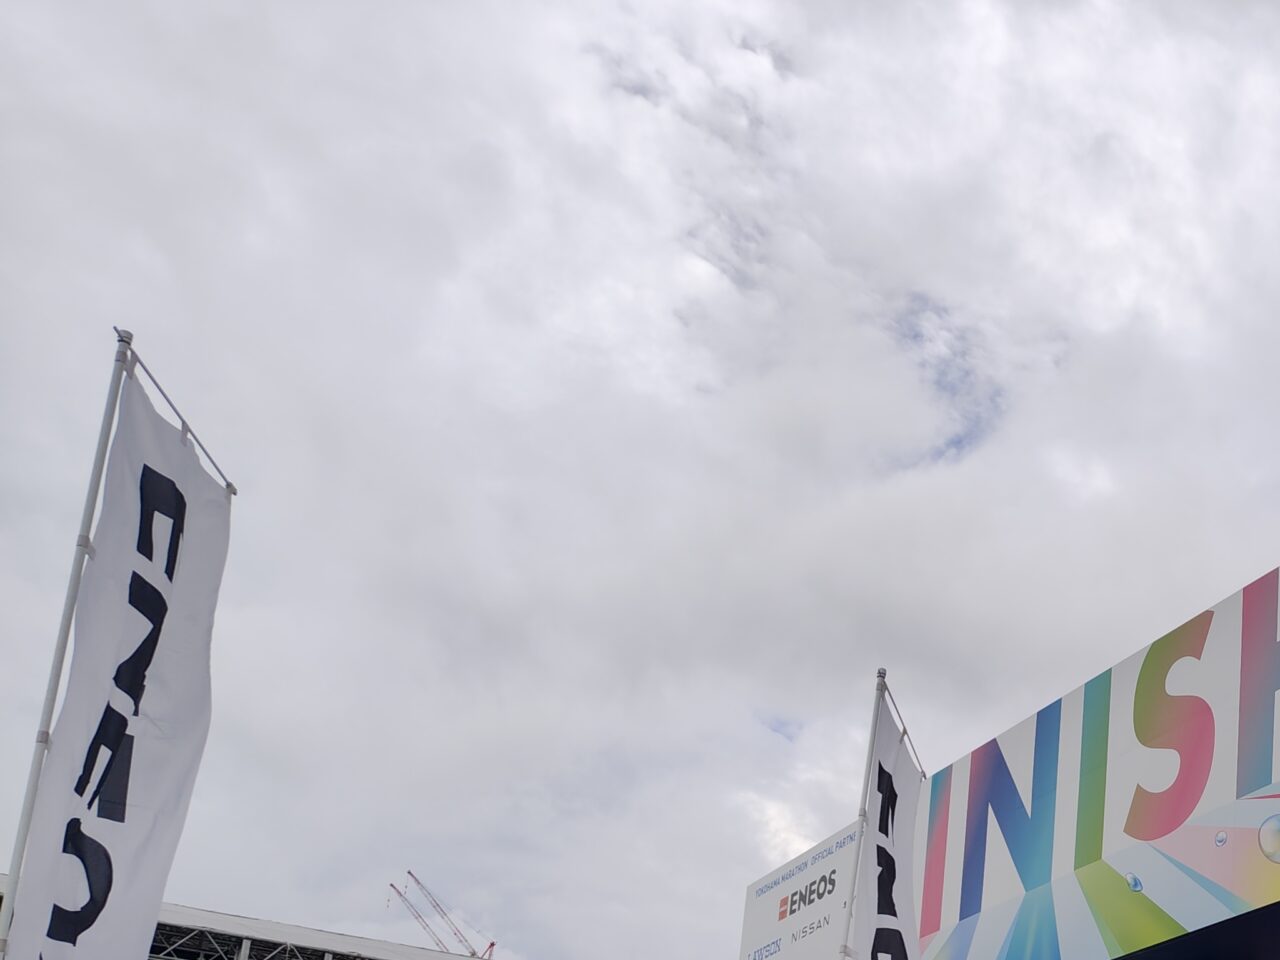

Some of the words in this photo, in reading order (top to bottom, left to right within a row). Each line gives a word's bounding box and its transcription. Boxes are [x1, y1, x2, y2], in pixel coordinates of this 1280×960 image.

[835, 831, 857, 853] PARTNE
[789, 868, 836, 916] ENEOS
[791, 914, 831, 944] NISSAN
